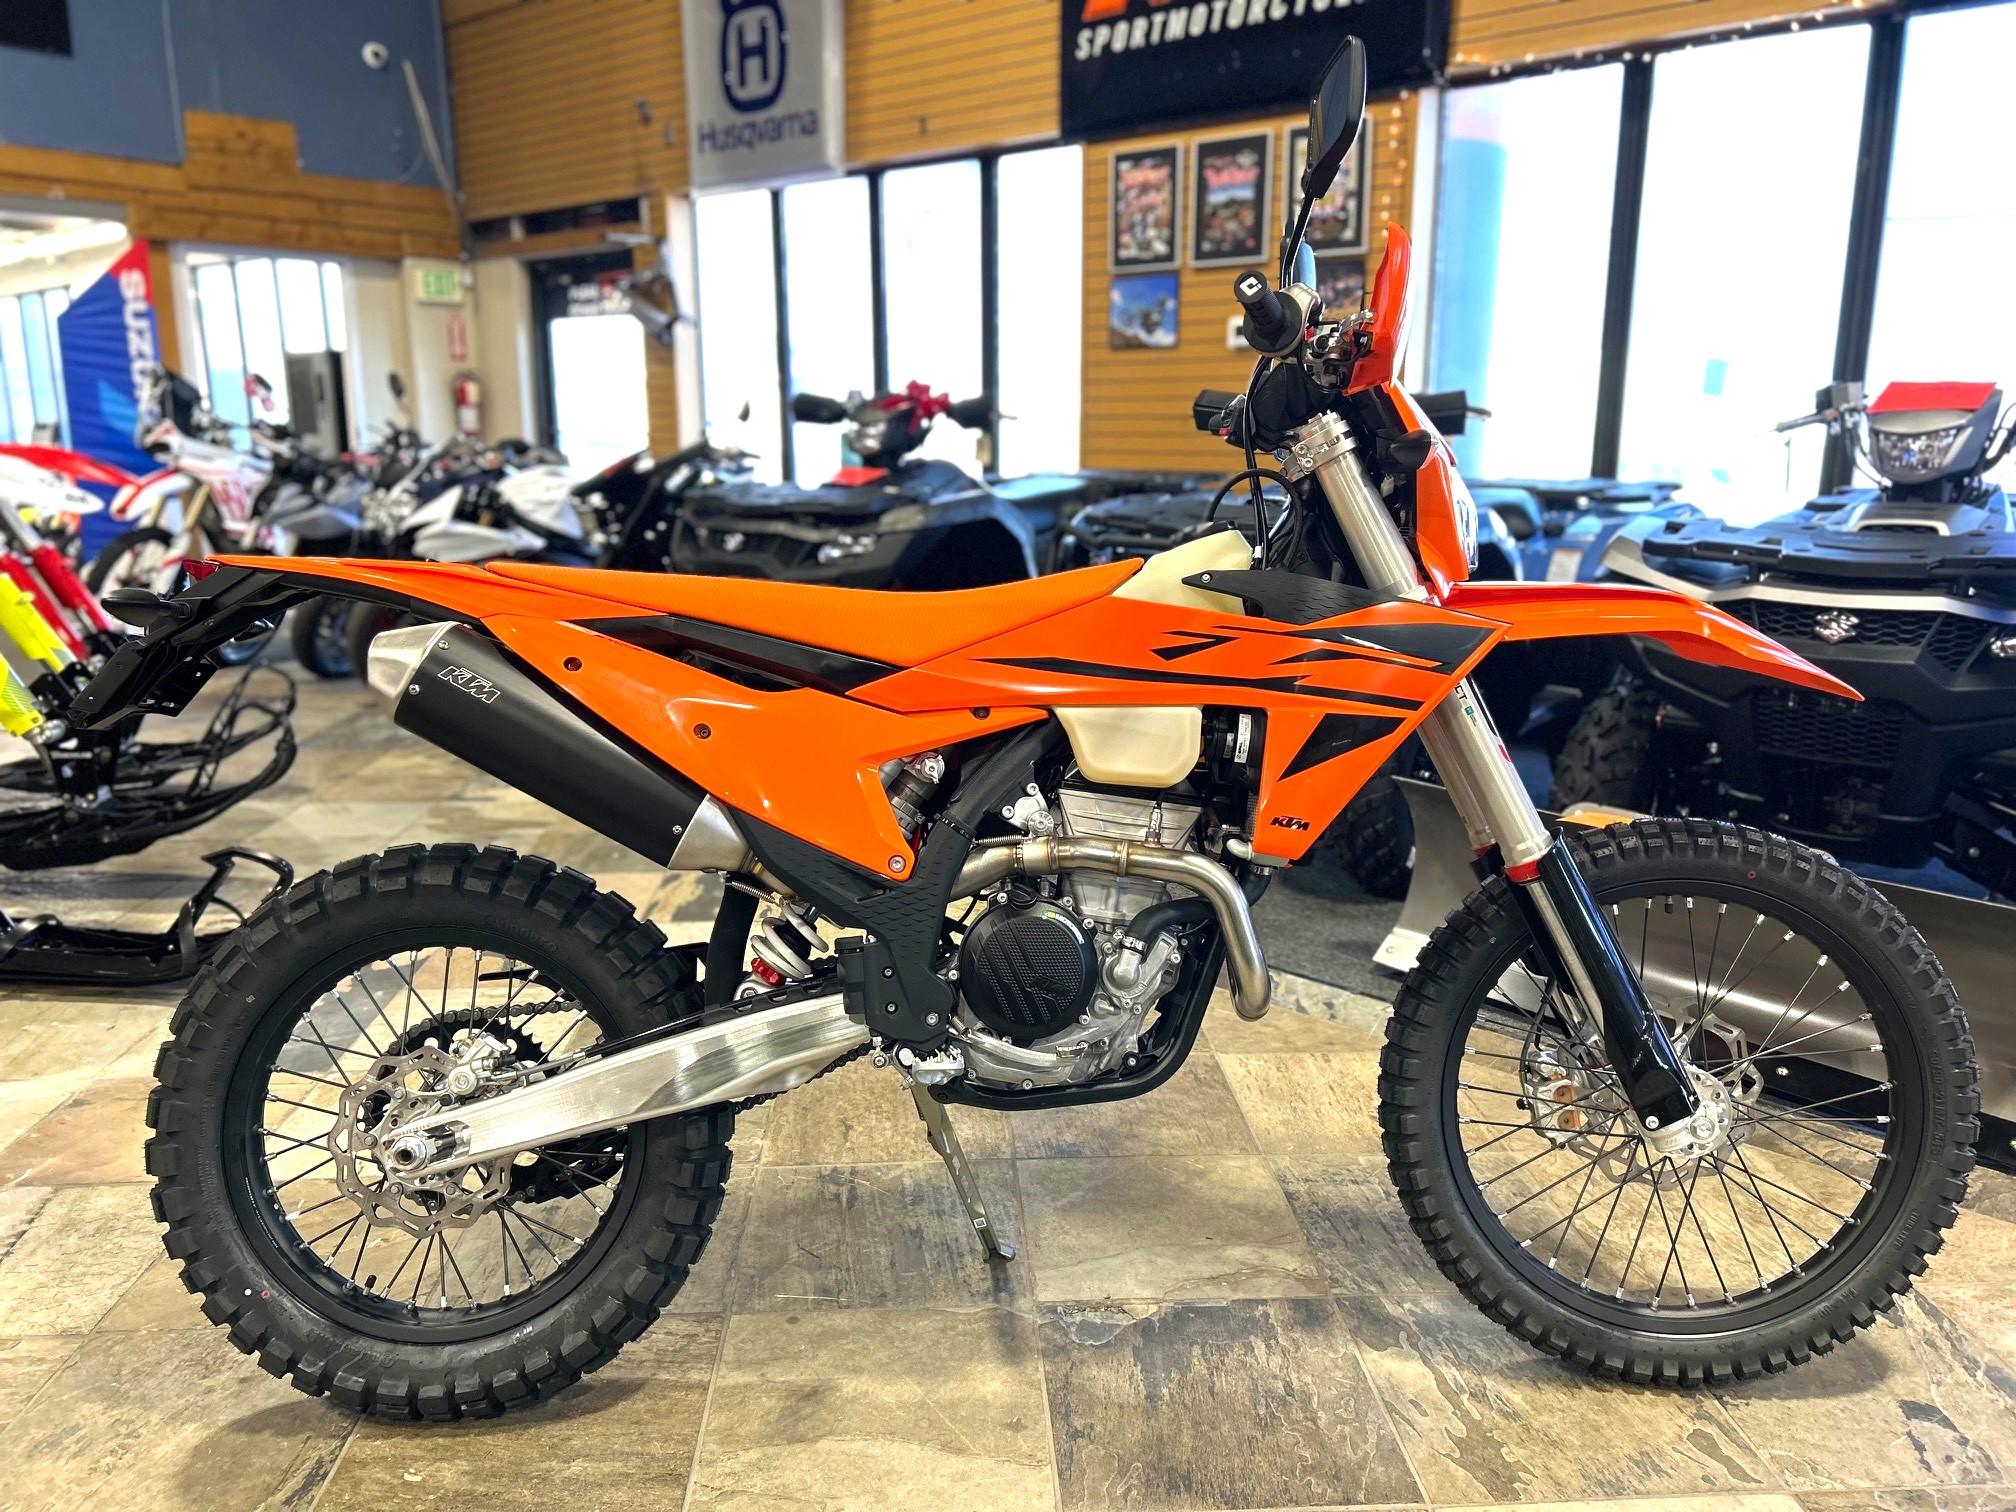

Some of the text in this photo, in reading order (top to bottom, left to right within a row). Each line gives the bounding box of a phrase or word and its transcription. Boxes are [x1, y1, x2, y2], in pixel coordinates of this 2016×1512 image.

[1074, 0, 1366, 60] SPORTMOTORCY
[697, 110, 818, 153] Husqvarna
[118, 267, 157, 402] SUZU
[437, 665, 501, 704] KTM
[1270, 815, 1310, 831] KTM
